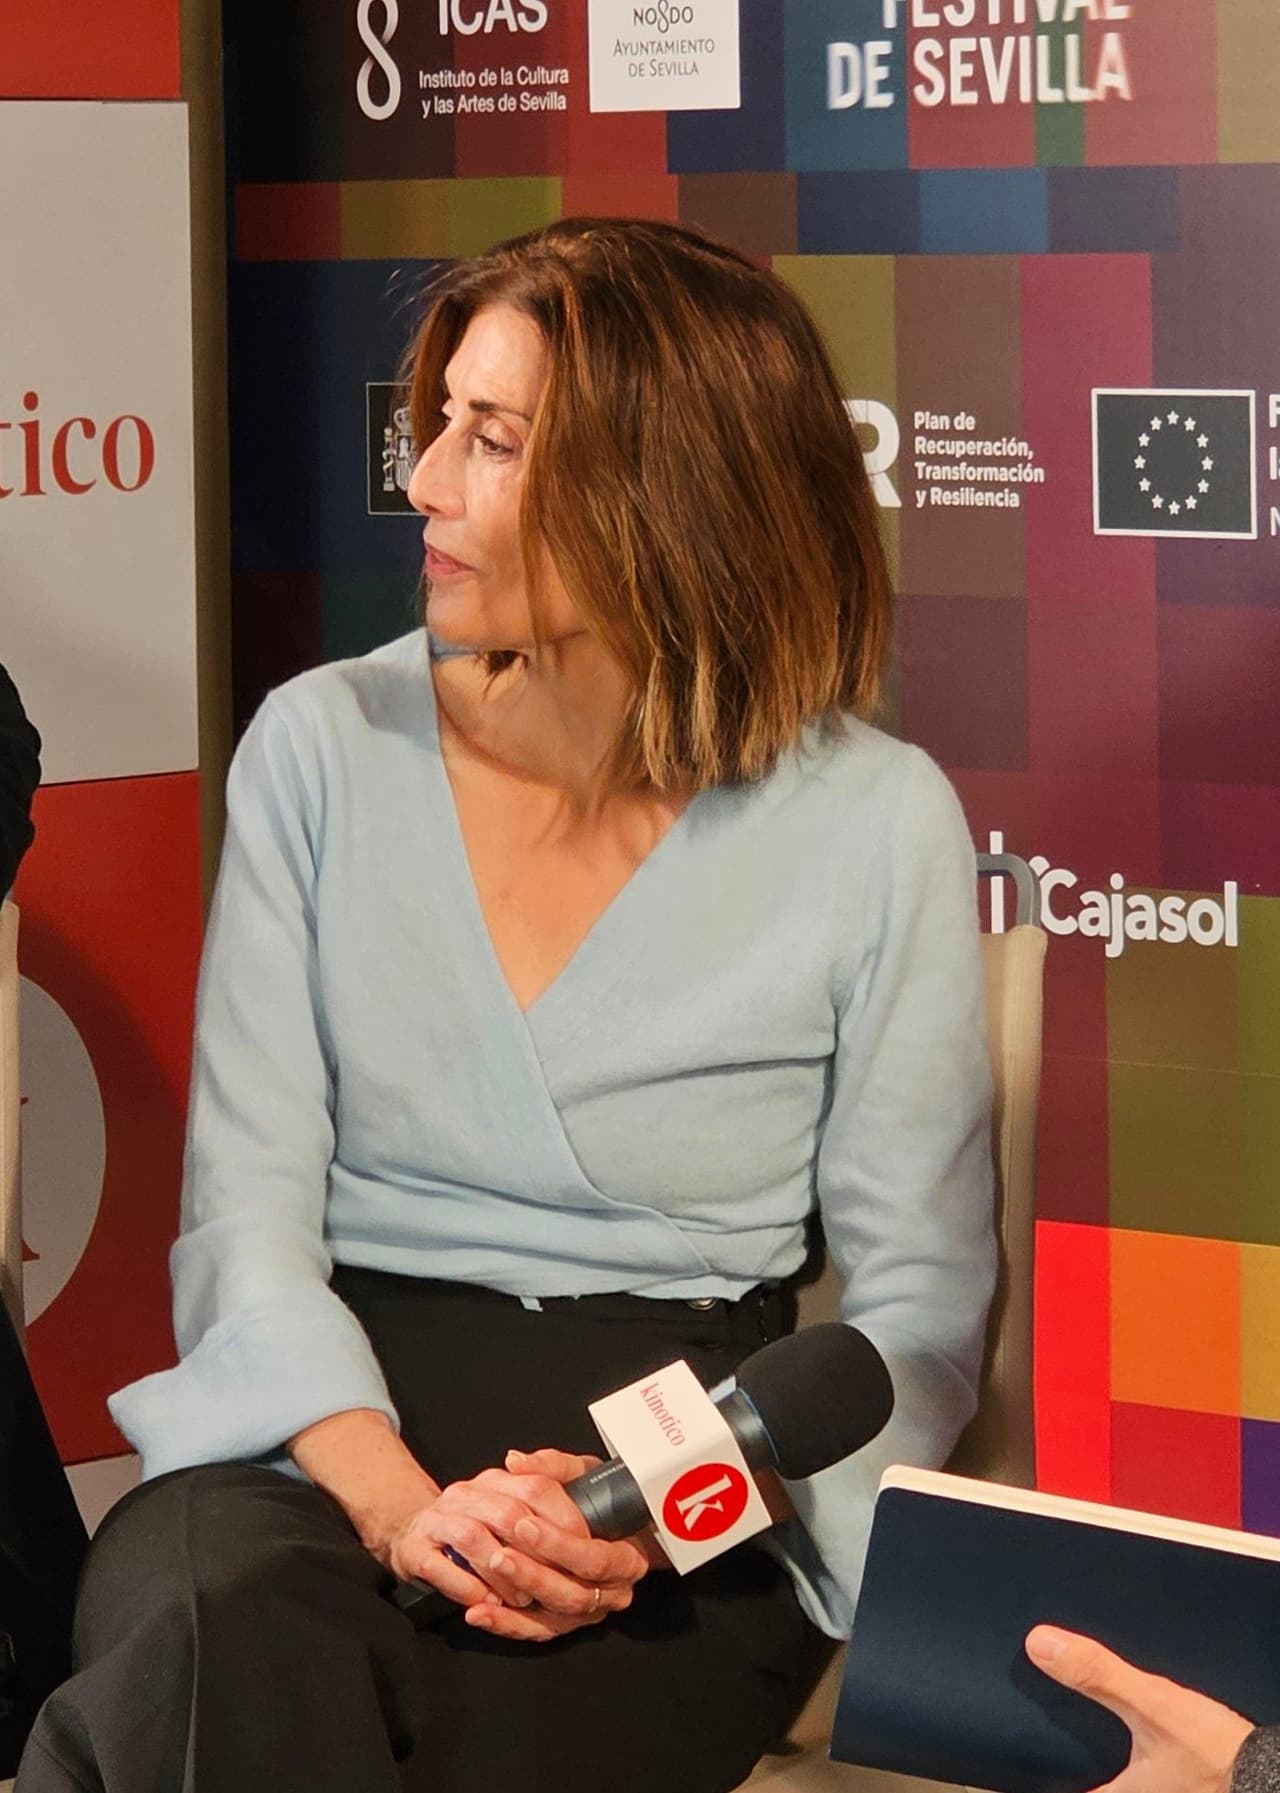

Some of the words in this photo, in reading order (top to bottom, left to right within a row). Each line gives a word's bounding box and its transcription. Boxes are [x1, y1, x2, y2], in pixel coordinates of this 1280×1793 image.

[613, 38, 715, 56] AYUNTAMIENTO
[419, 70, 475, 88] Instituto
[479, 68, 497, 86] de
[501, 67, 513, 85] la
[517, 66, 569, 85] Cultura
[650, 58, 700, 77] SEVILLA
[827, 41, 894, 110] DE
[913, 32, 1134, 107] SEVILLA
[422, 99, 431, 118] y
[435, 95, 454, 114] las
[457, 95, 494, 113] Artes
[498, 93, 516, 111] de
[520, 92, 566, 111] Sevilla
[914, 411, 950, 430] Plan
[954, 412, 976, 430] de
[915, 436, 1033, 459] Recuperación,
[914, 461, 1045, 482] Transformación
[915, 489, 927, 508] y
[930, 487, 1020, 507] Resiliencia
[1040, 868, 1239, 958] Cajasol
